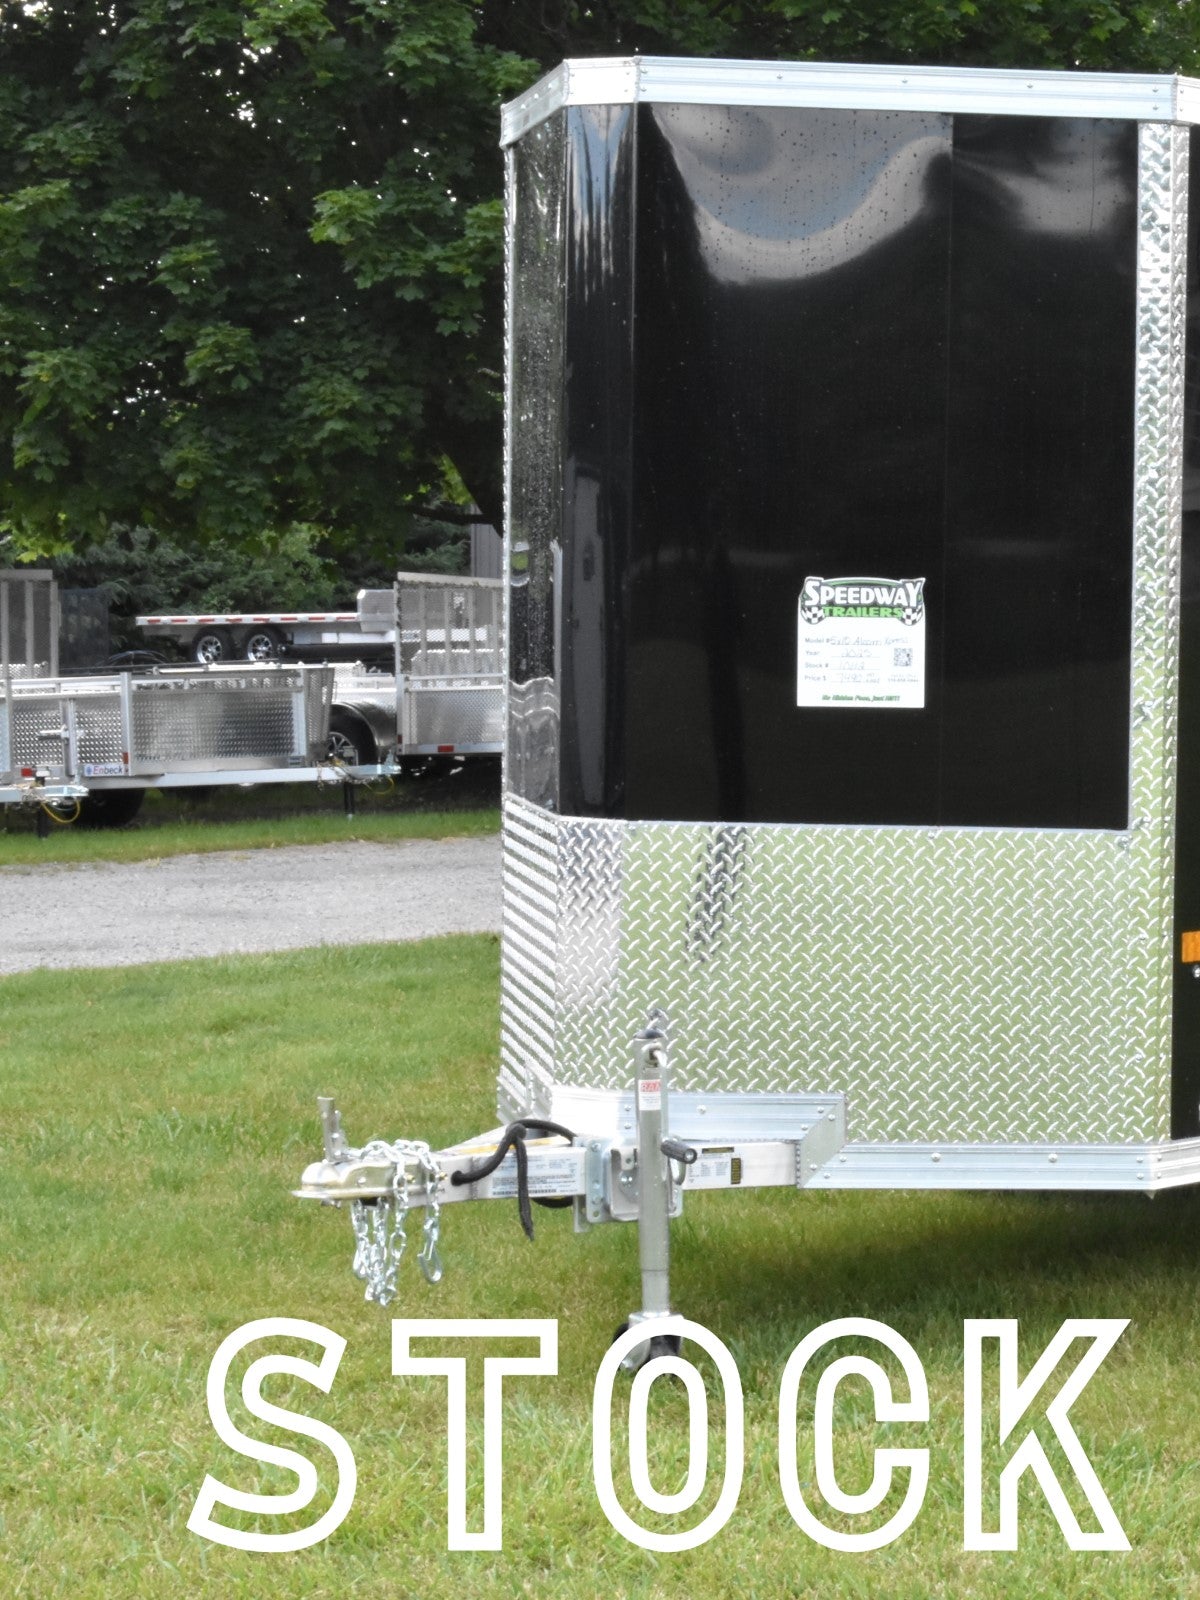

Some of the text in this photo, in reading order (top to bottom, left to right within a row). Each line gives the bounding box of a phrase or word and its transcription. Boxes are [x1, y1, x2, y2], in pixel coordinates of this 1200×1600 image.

[804, 580, 920, 607] SPEEDWAY
[823, 606, 904, 618] TRAILERS
[93, 765, 123, 775] Enbeck
